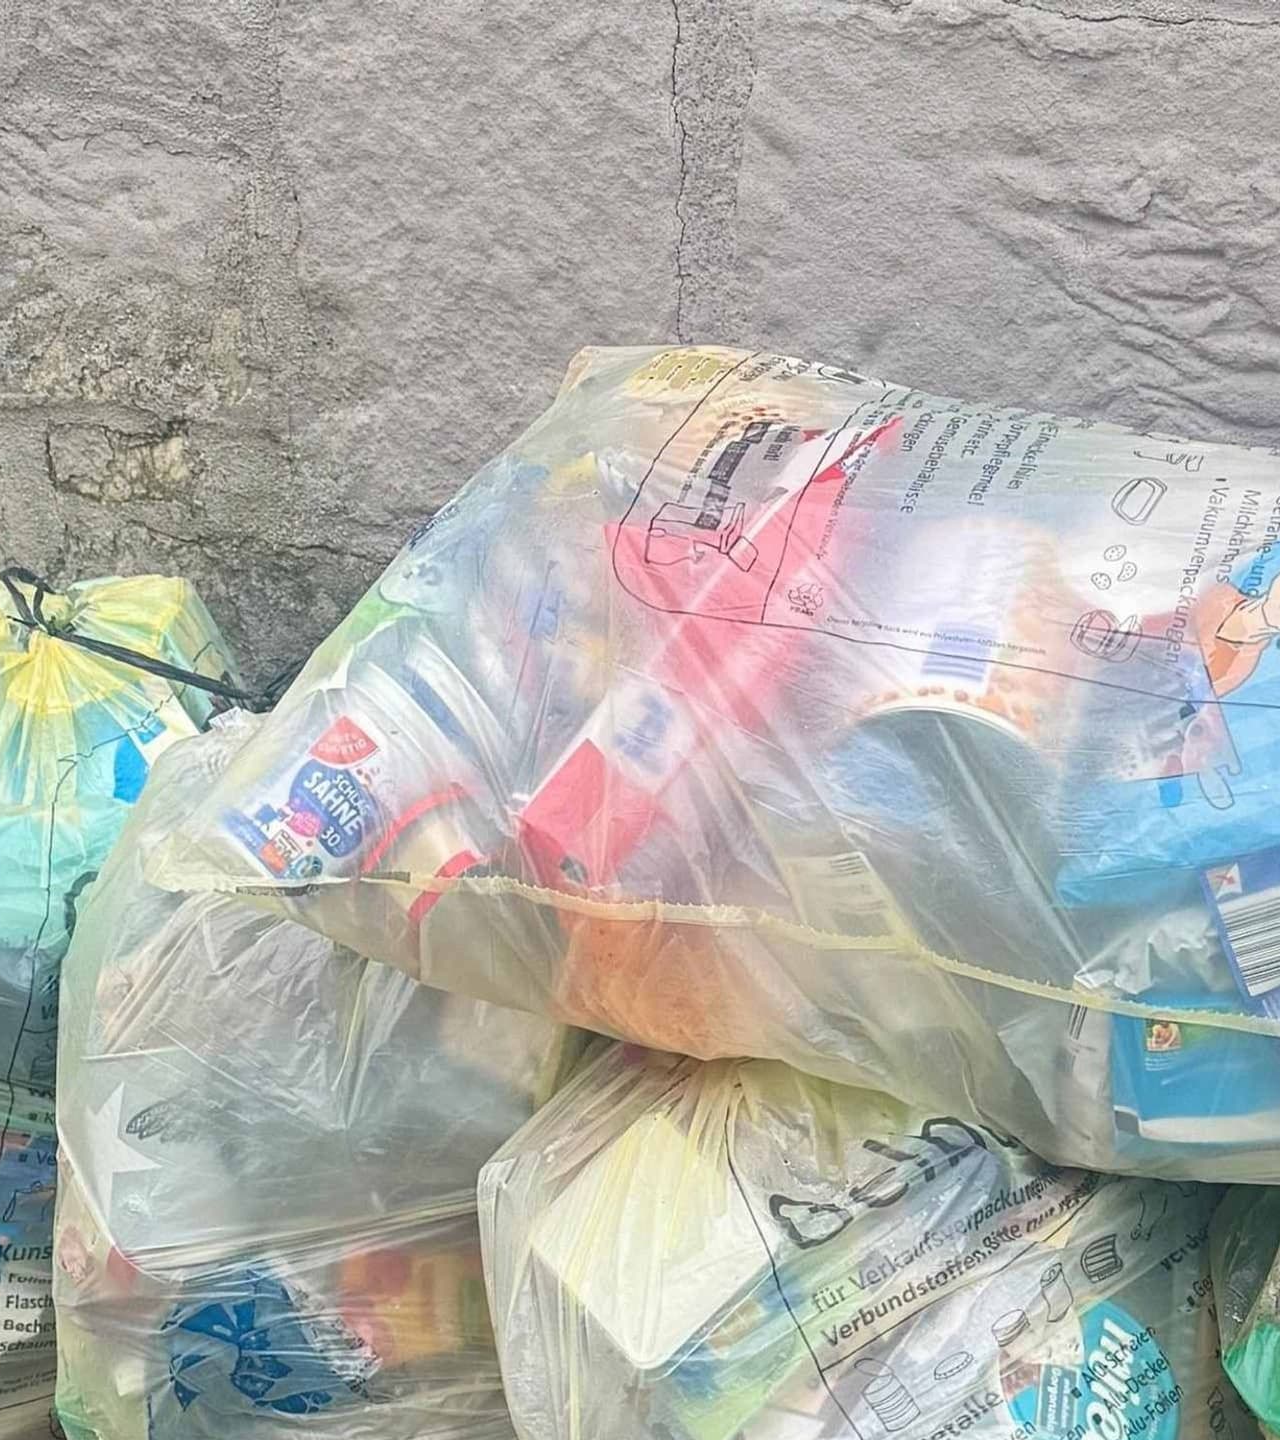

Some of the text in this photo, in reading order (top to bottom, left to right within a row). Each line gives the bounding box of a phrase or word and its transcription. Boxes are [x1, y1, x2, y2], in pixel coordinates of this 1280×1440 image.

[1165, 486, 1230, 664] Vakuumverpackungen
[303, 770, 362, 836] SAHNE
[810, 1283, 847, 1314] für
[1102, 1351, 1171, 1414] Alu-Deckel
